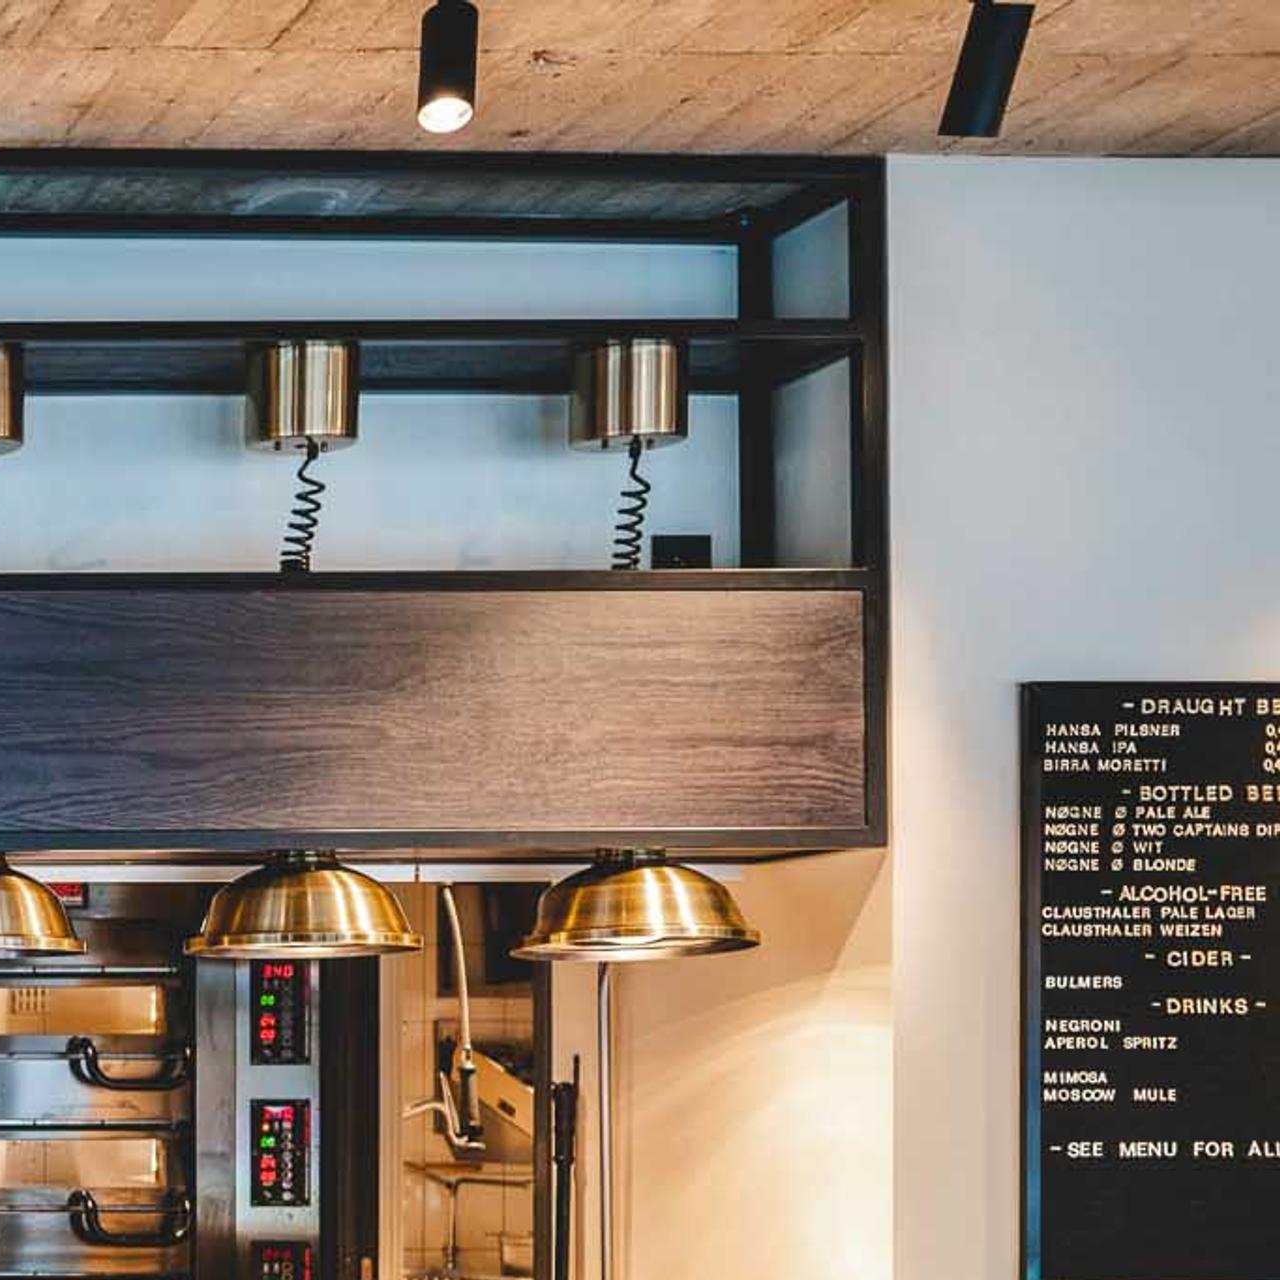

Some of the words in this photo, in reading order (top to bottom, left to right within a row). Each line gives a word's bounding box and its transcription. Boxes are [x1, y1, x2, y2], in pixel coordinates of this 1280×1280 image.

[1141, 697, 1247, 717] DRAUGHT
[1046, 723, 1102, 737] HANSA
[1114, 723, 1180, 737] PILSNER
[1045, 740, 1100, 755] HANSA
[1112, 741, 1138, 755] IPA
[1043, 758, 1090, 772] BIRRA
[1097, 758, 1167, 772] MORETTI
[1139, 784, 1233, 802] BOTTLED
[1045, 805, 1102, 820] NØGNE
[1135, 805, 1176, 819] PALE
[1182, 805, 1211, 820] ALE
[1044, 823, 1099, 837] NØGNE
[1131, 823, 1167, 837] TWO
[1172, 822, 1250, 838] CAPTAINS
[1044, 840, 1100, 855] NØGNE
[1132, 840, 1163, 854] WIT
[1044, 858, 1100, 872] NØGNE
[1132, 858, 1197, 872] BLONDE
[1041, 905, 1152, 920] CLAUSTHALER
[1160, 905, 1199, 920] PALE
[1204, 905, 1256, 920] LAGER
[1041, 922, 1152, 937] CLAUSTHALER
[1159, 923, 1223, 938] WEIZEN
[1166, 950, 1234, 967] CIDER
[1044, 975, 1123, 990] BULMERS
[1166, 997, 1249, 1015] DRINKS
[1045, 1019, 1121, 1033] NEGRONI
[1044, 1036, 1109, 1050] APEROL
[1122, 1036, 1178, 1050] SPRITZ
[1043, 1070, 1108, 1085] MIMOSA
[1043, 1088, 1117, 1102] MOSCOW
[1133, 1087, 1177, 1102] MULE
[1118, 1141, 1178, 1158] MENU
[1193, 1140, 1234, 1158] FOR
